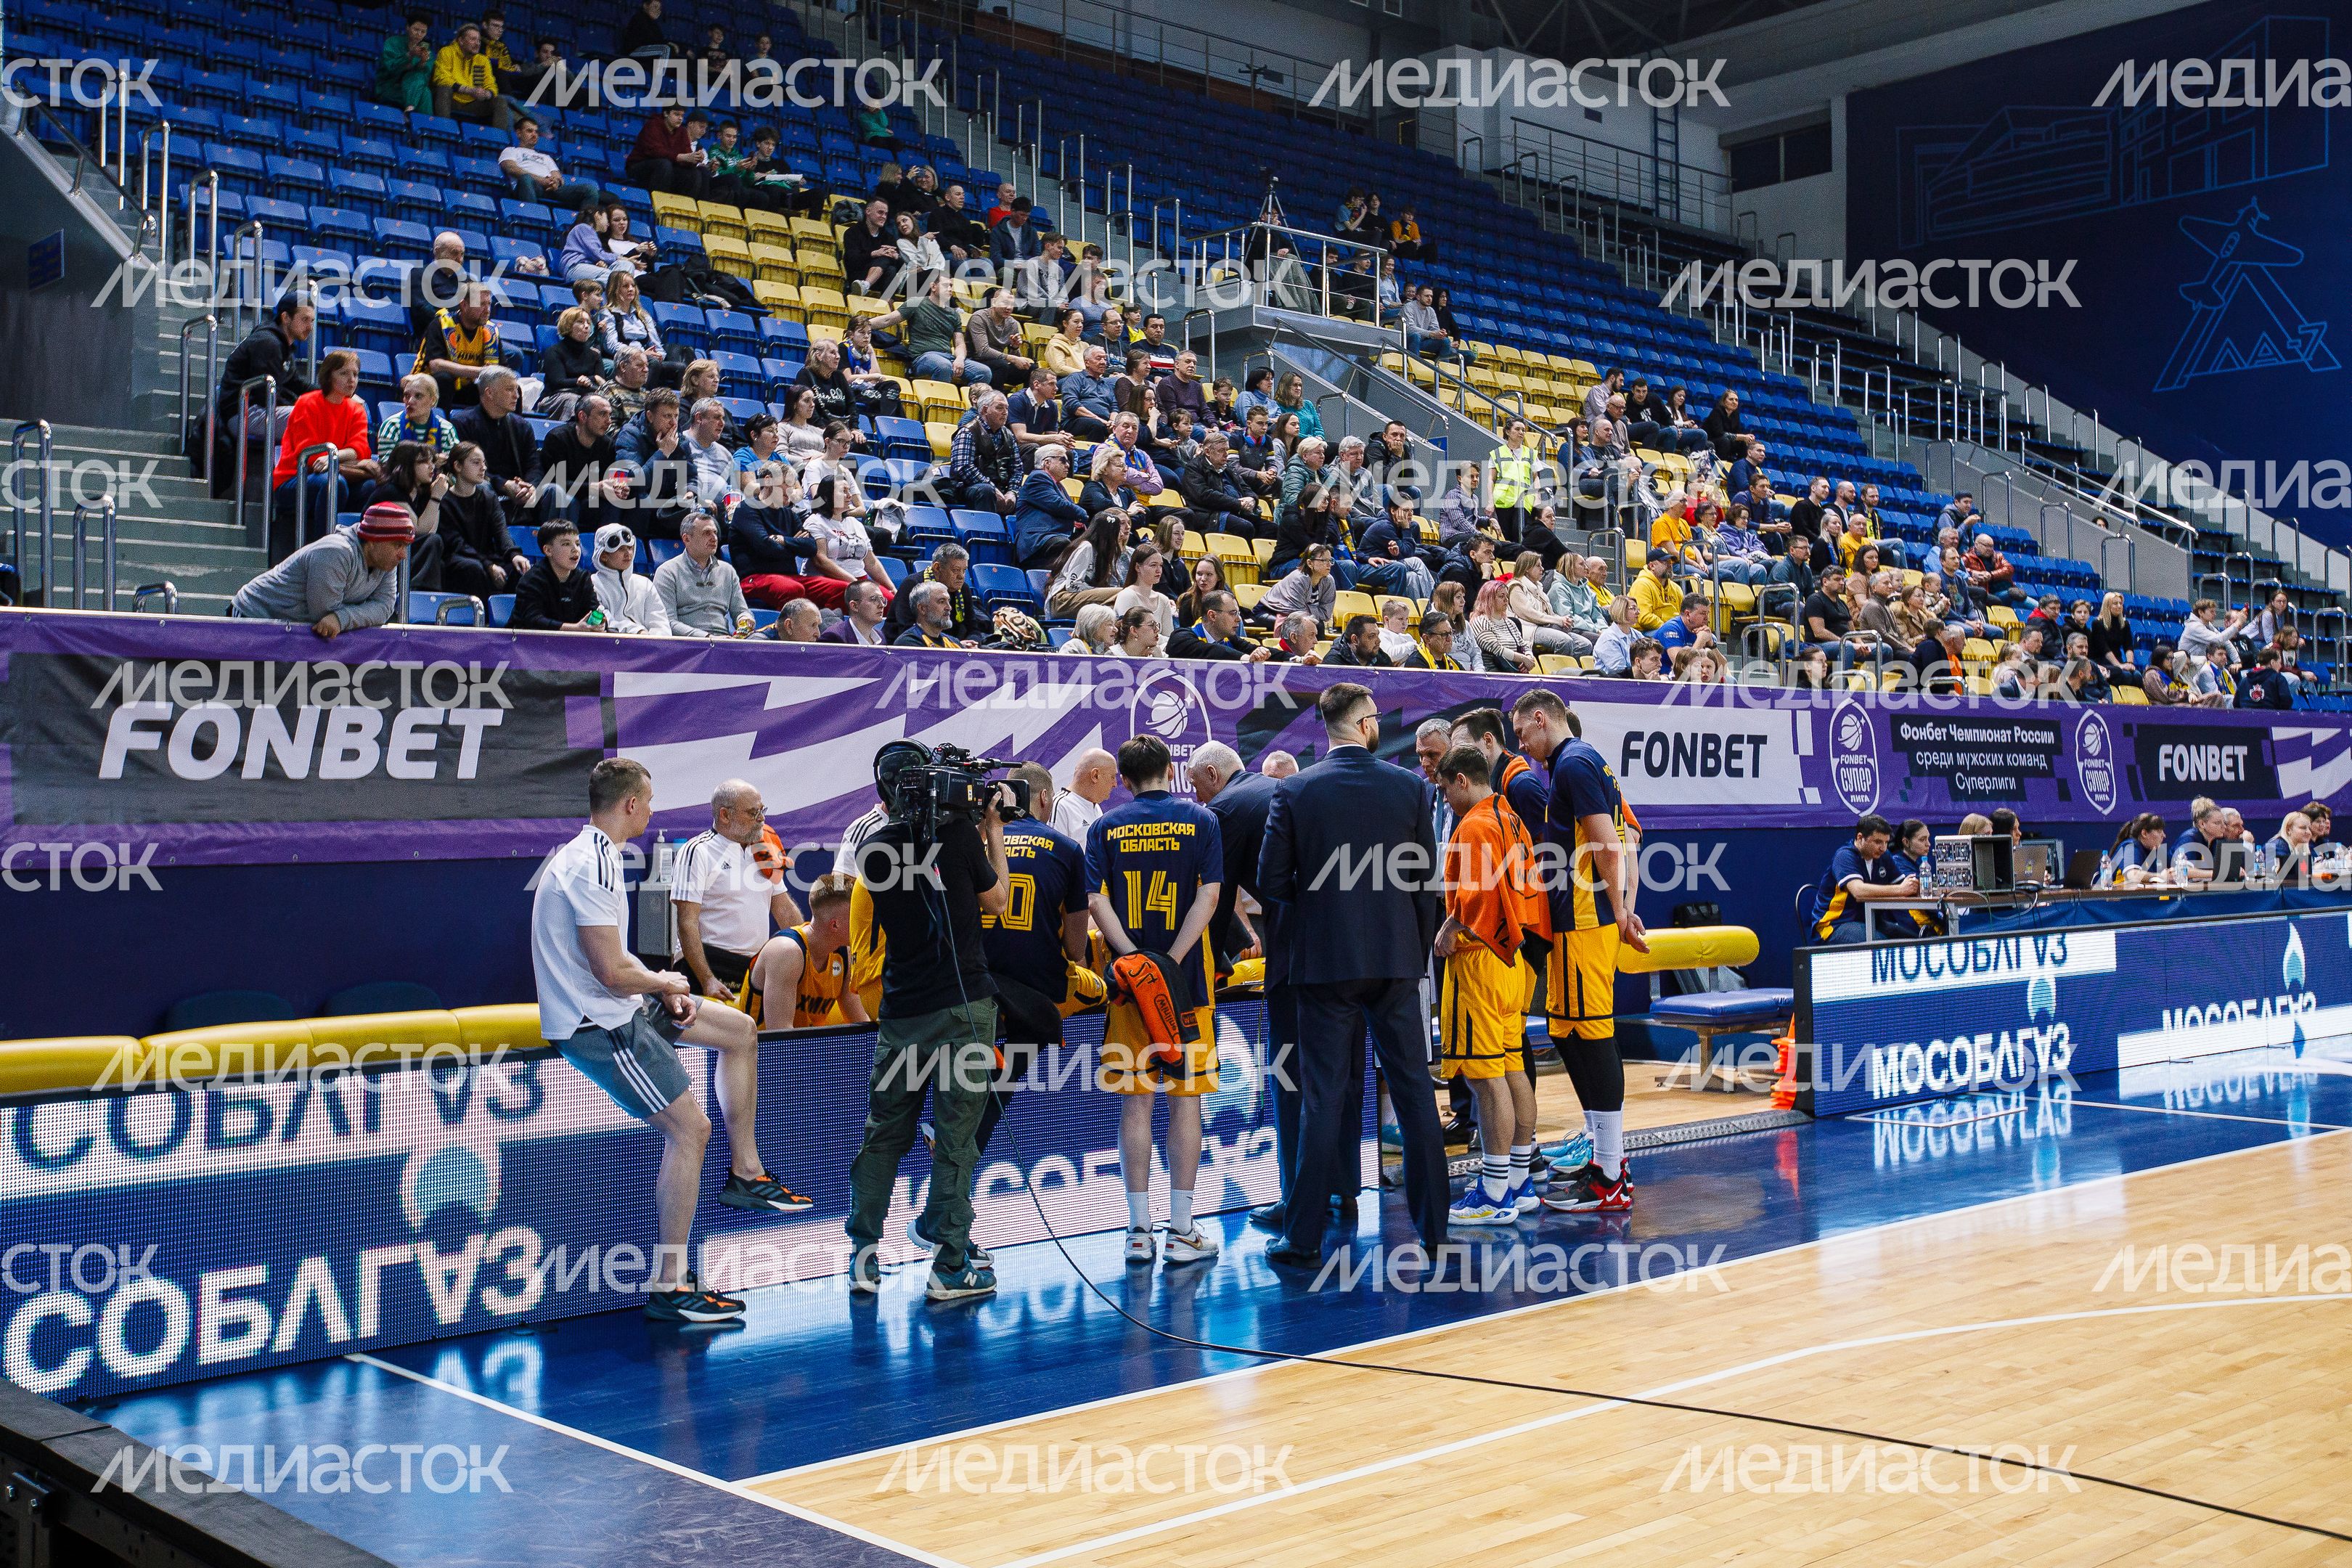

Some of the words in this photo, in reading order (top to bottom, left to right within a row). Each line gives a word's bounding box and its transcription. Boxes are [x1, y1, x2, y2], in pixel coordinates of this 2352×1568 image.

[99, 701, 503, 780] FONBET
[1900, 722, 1947, 742] Фонбет
[1949, 724, 2012, 744] Чемпионат
[2014, 726, 2055, 745] России
[1621, 731, 1768, 779] FONBET
[1840, 754, 1868, 765] FONBET
[1916, 751, 1953, 770] среди
[1957, 752, 2004, 771] мужских
[2006, 754, 2047, 770] команд
[2084, 759, 2105, 769] FONBET
[2159, 744, 2247, 783] FONBET
[1956, 772, 2017, 795] Суперлиги
[1850, 794, 1871, 804] ЛИГА
[1107, 822, 1196, 841] МОСКОВСКАЯ
[1003, 835, 1054, 852] ОВСКАЯ
[1005, 846, 1037, 859] АСТЬ
[1120, 838, 1180, 852] ОБЛАСТЬ
[1123, 870, 1177, 930] 14
[1871, 1021, 2072, 1100] МОСОБЛГАЗ
